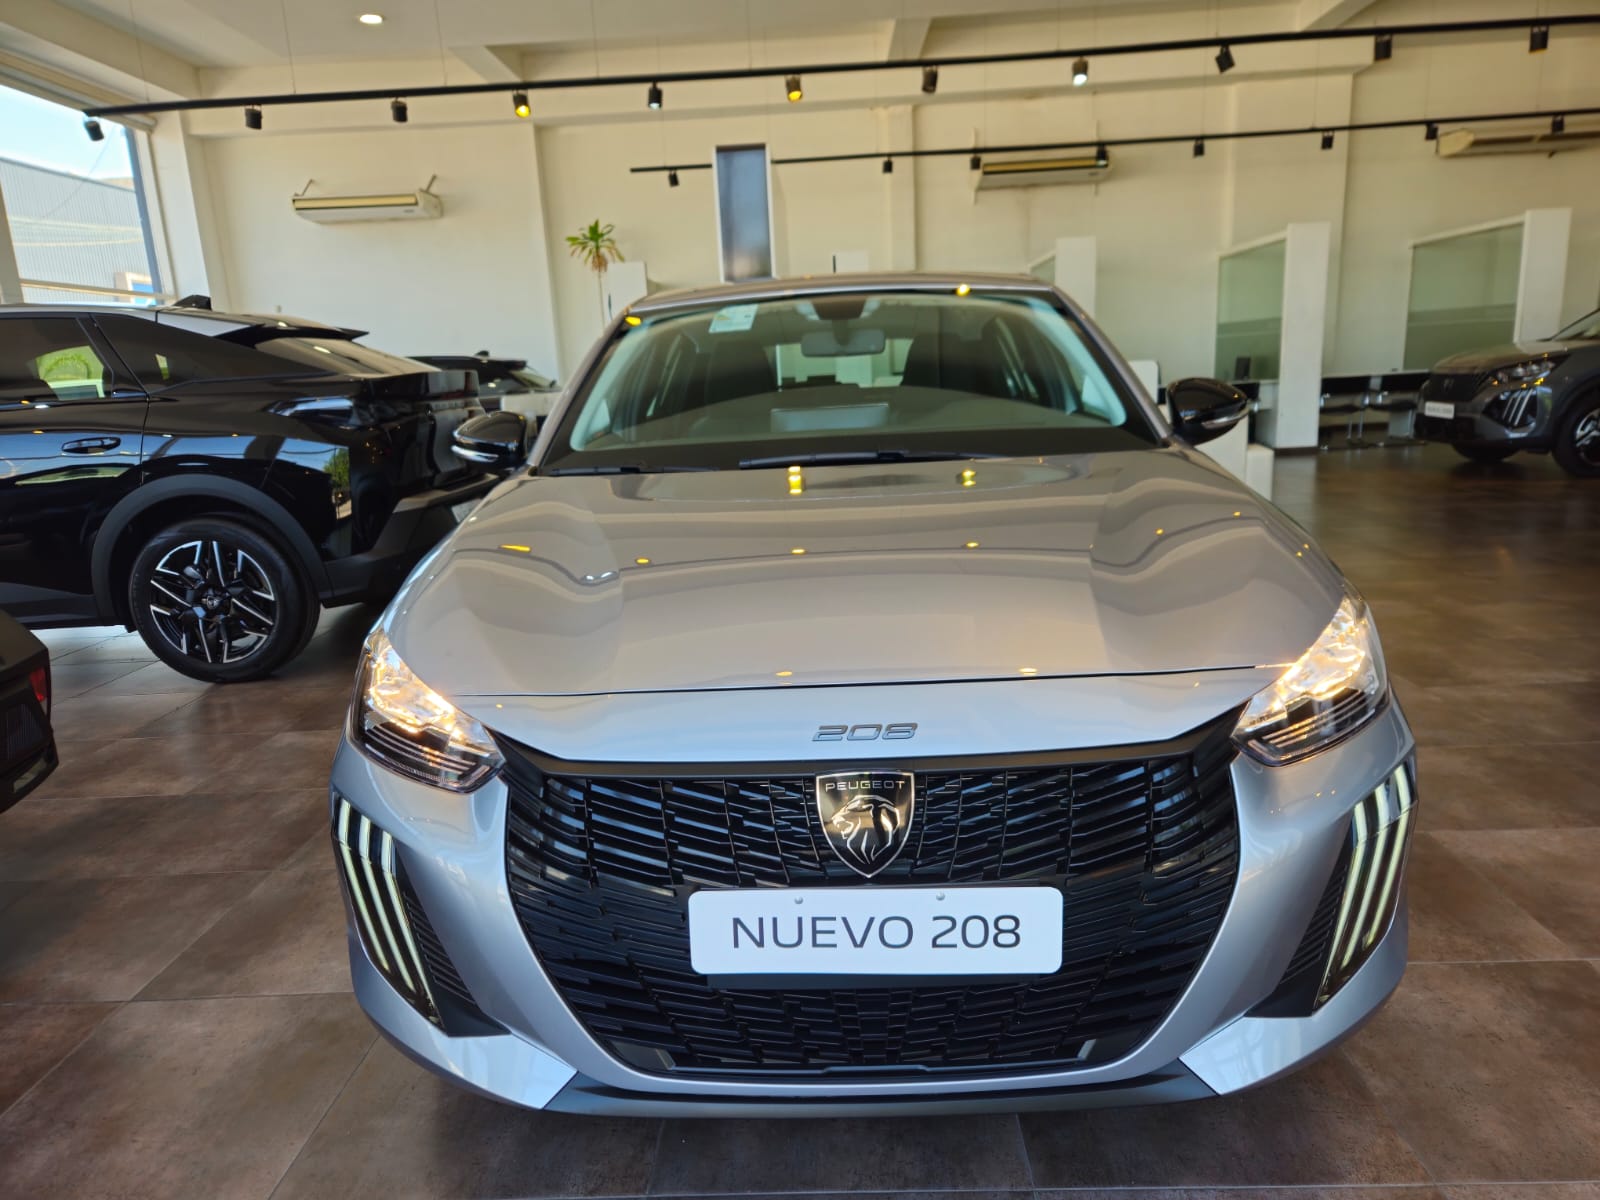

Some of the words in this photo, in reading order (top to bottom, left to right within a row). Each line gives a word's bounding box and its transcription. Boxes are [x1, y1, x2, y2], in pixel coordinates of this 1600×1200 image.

[811, 722, 918, 742] 208
[825, 780, 905, 792] PEUGEOT
[732, 916, 914, 949] NUEVO
[931, 915, 1021, 949] 208
